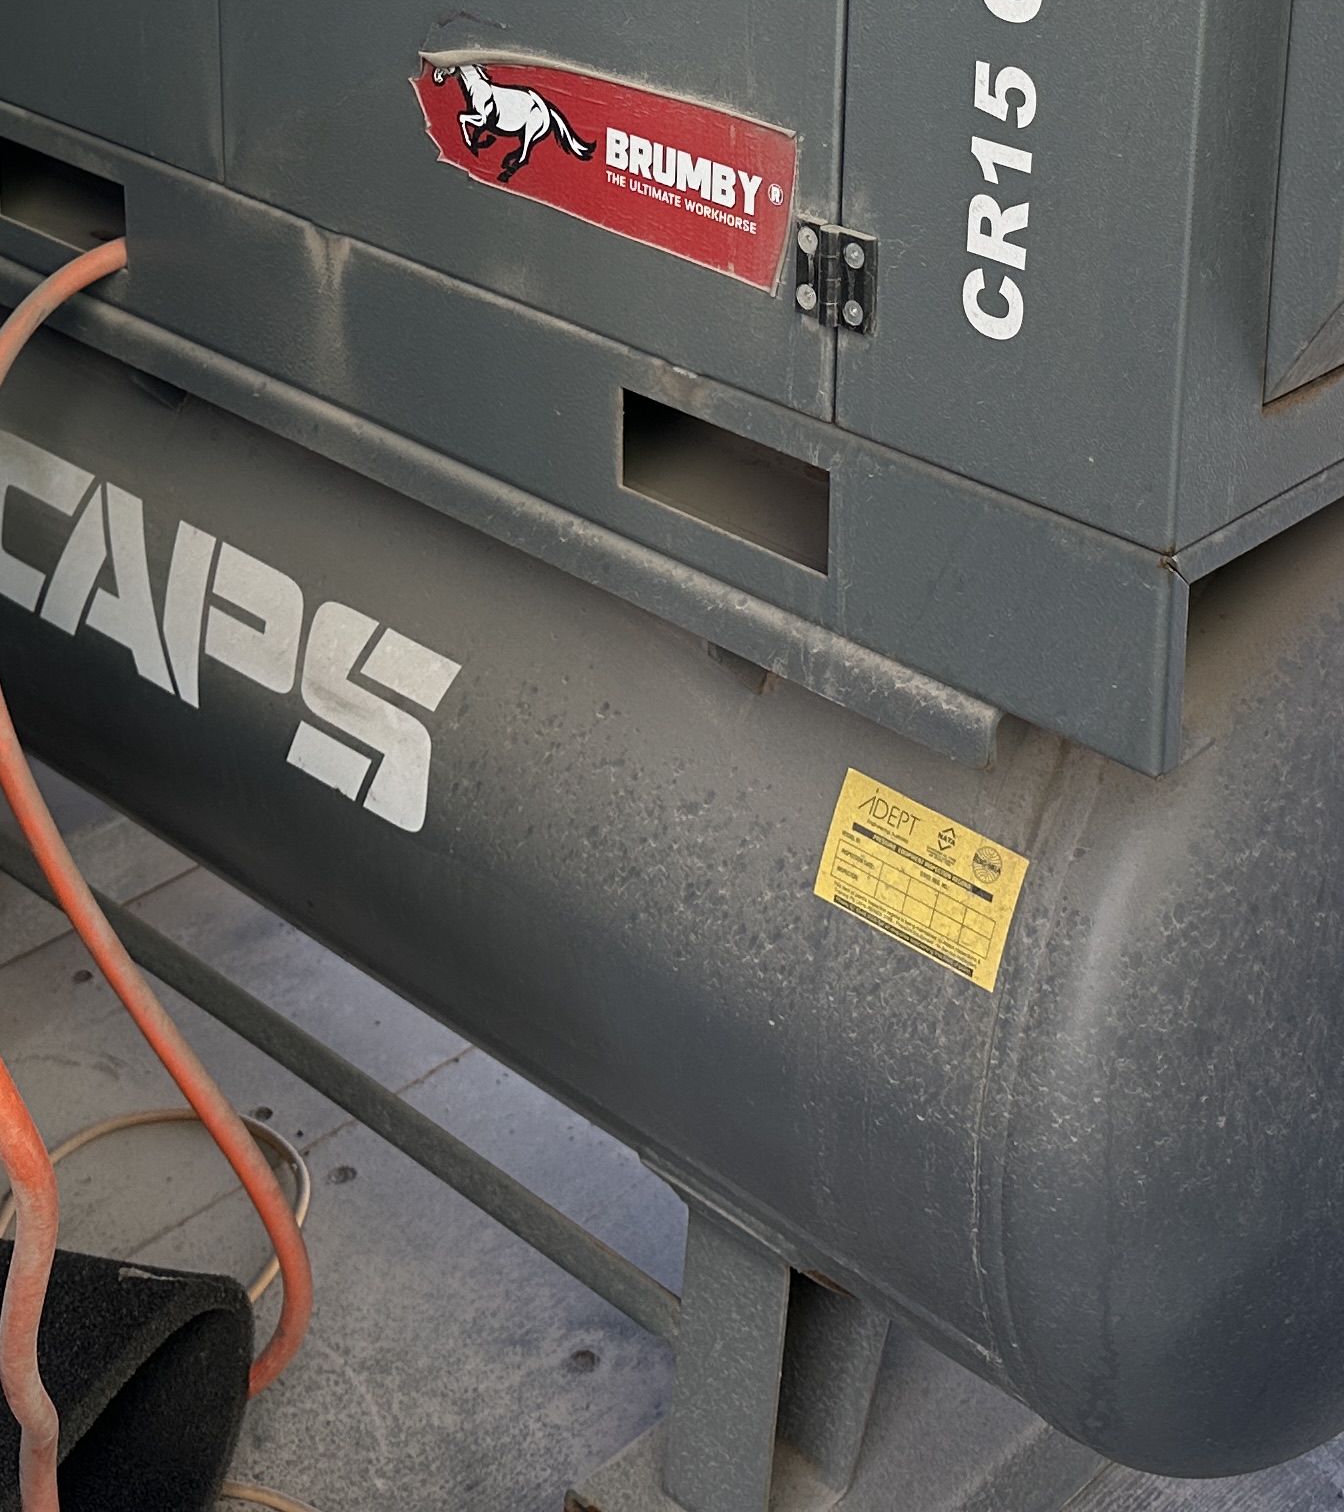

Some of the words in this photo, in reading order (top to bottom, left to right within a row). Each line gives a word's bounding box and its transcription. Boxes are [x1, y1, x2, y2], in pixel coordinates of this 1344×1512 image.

[605, 127, 763, 216] BRUMBY
[605, 170, 626, 190] THE
[629, 177, 682, 208] ULTIMATE
[684, 198, 758, 236] WORKHORSE
[962, 59, 1037, 341] CR15
[858, 795, 921, 836] ADEPT
[938, 831, 956, 847] NATA
